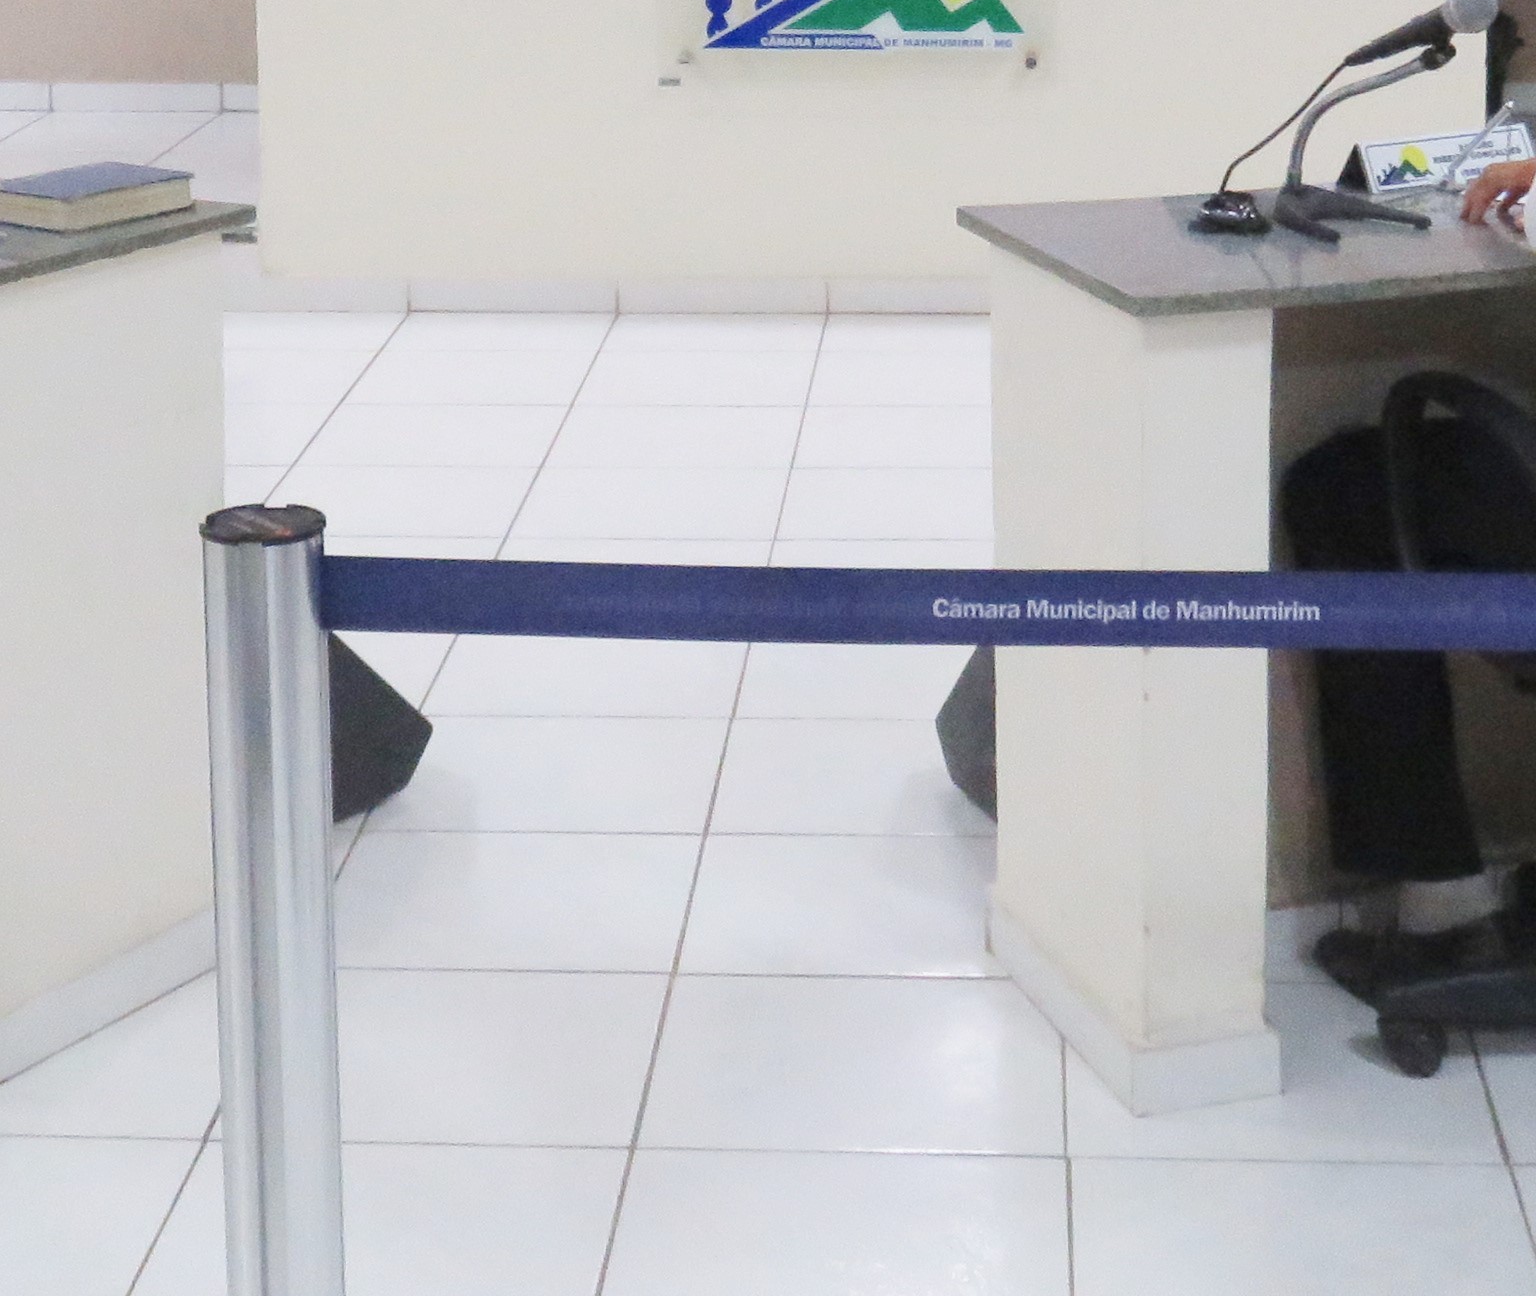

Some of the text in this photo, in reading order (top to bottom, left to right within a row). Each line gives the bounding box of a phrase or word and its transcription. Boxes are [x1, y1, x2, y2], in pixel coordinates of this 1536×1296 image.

[884, 38, 899, 48] DE
[903, 38, 984, 48] MANHUMIRIM
[994, 38, 1013, 48] MG
[932, 598, 1321, 624] Câmara Municipal de Manhumirim
